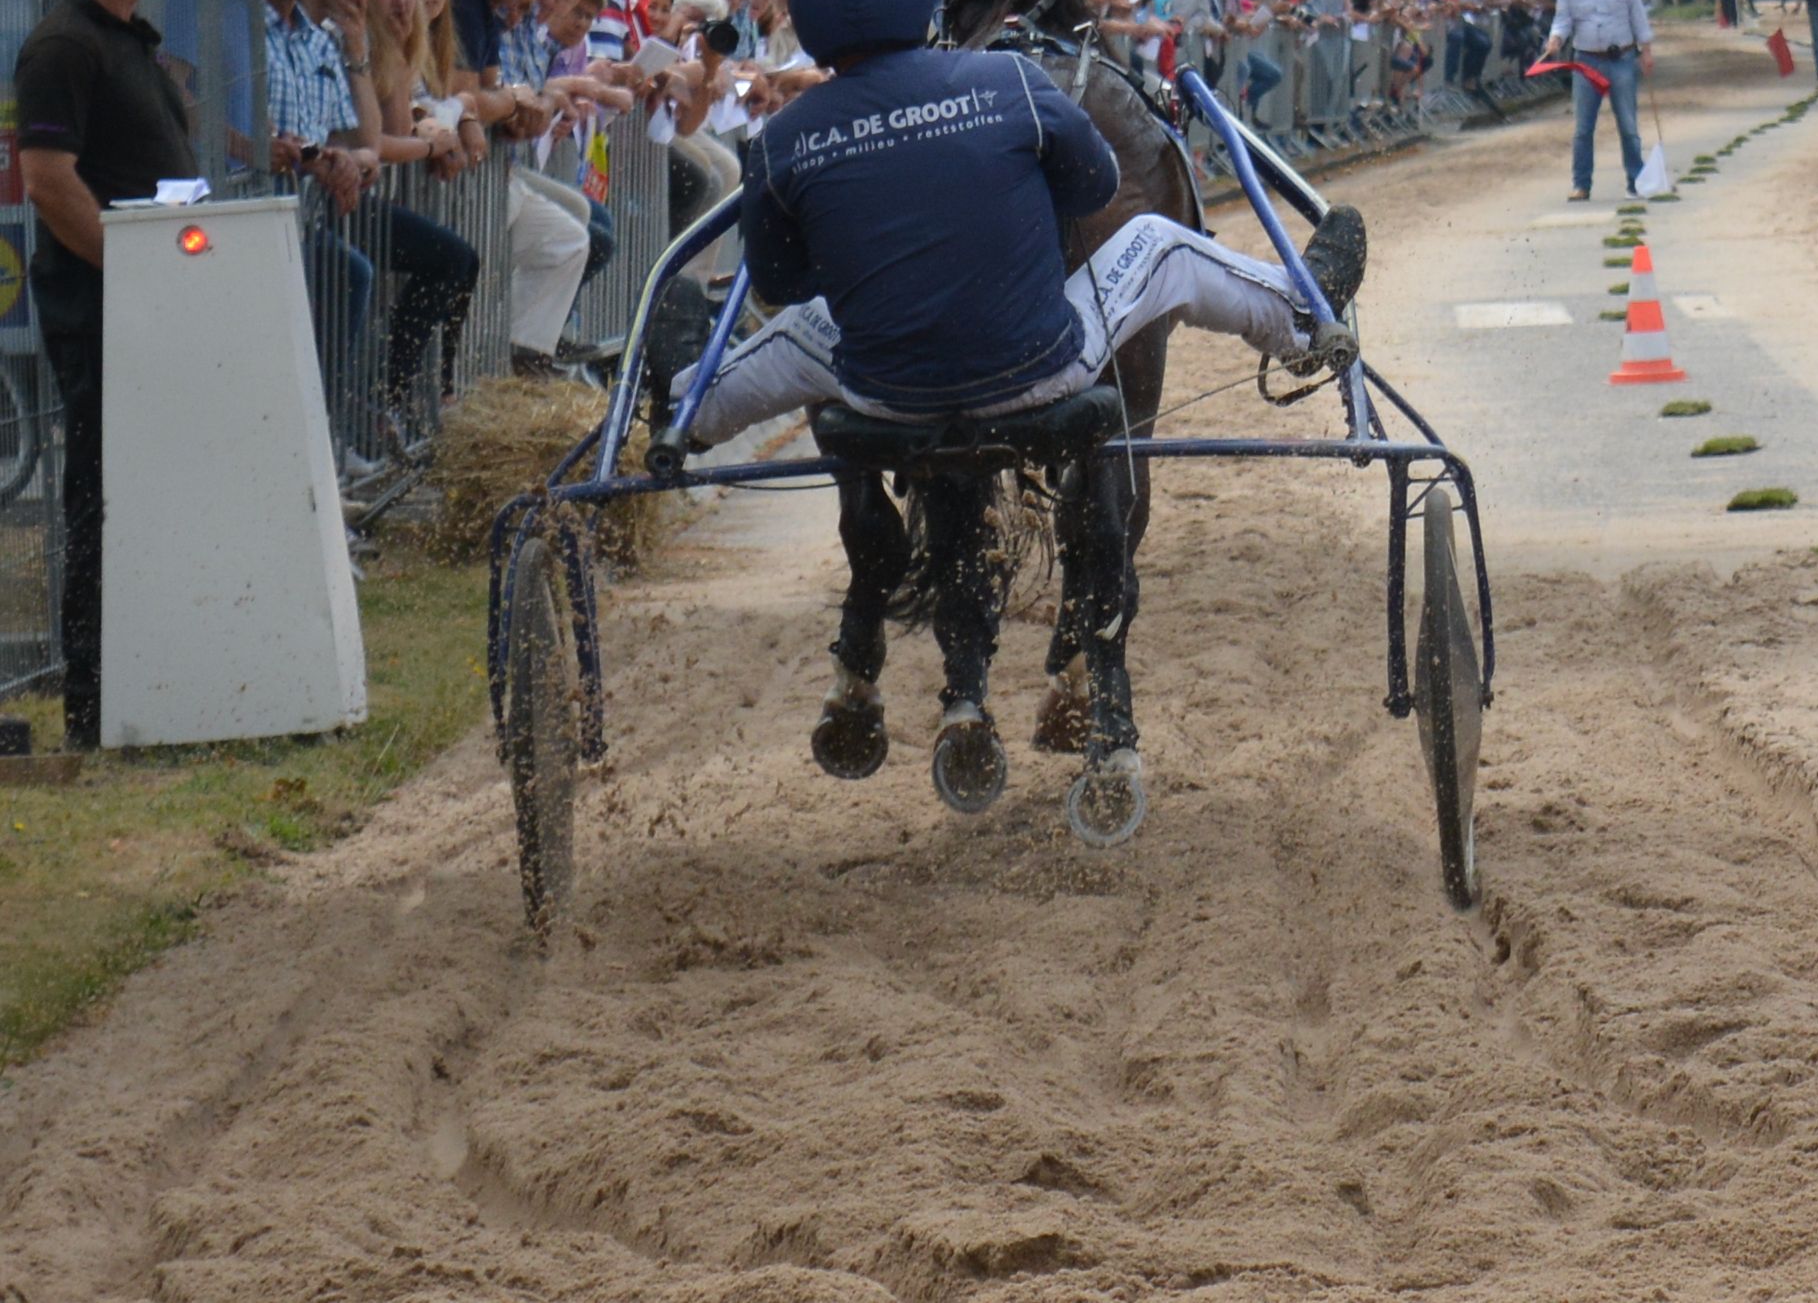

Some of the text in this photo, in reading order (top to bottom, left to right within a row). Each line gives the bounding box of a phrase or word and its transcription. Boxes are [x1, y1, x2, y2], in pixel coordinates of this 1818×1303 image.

[808, 95, 971, 151] C.A. DE GROOT
[845, 138, 895, 157] milieu
[917, 114, 1003, 142] reststoffen
